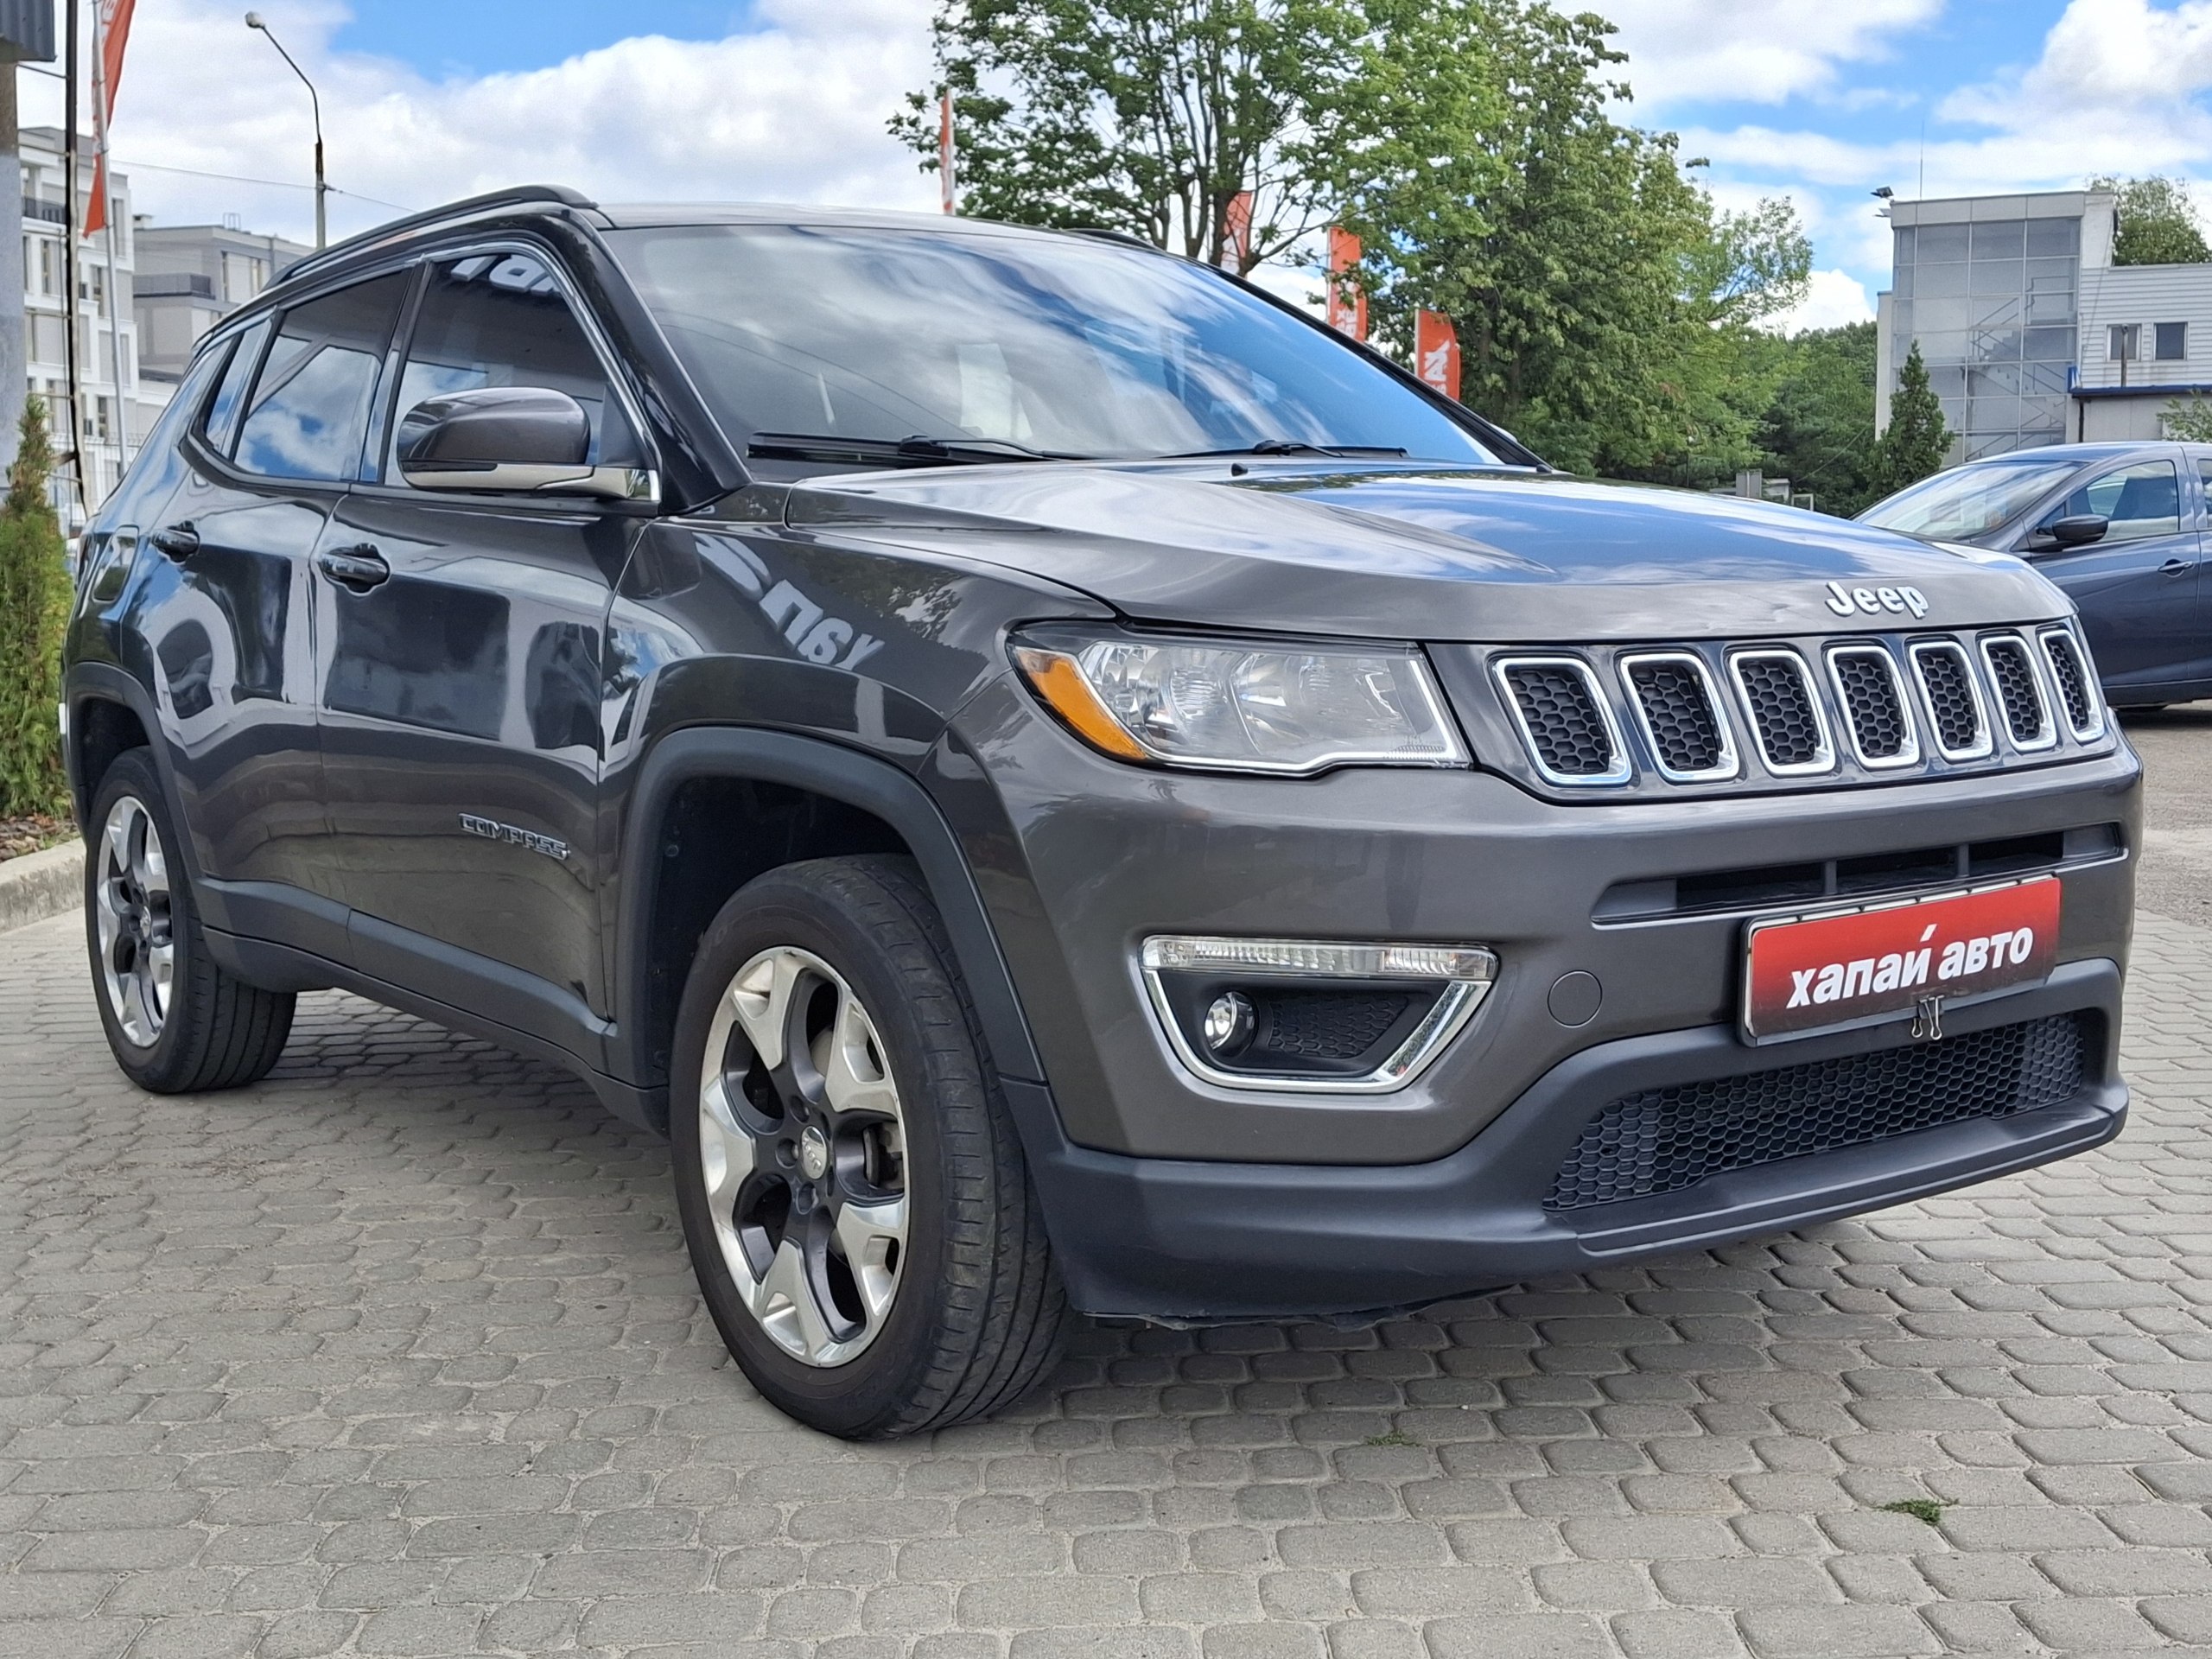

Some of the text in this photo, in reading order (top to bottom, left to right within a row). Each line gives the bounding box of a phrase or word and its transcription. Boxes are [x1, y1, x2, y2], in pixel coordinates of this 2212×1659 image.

[1825, 581, 1929, 620] Jeep
[458, 812, 571, 860] COMPASS
[1785, 923, 2034, 1010] хапай авто
